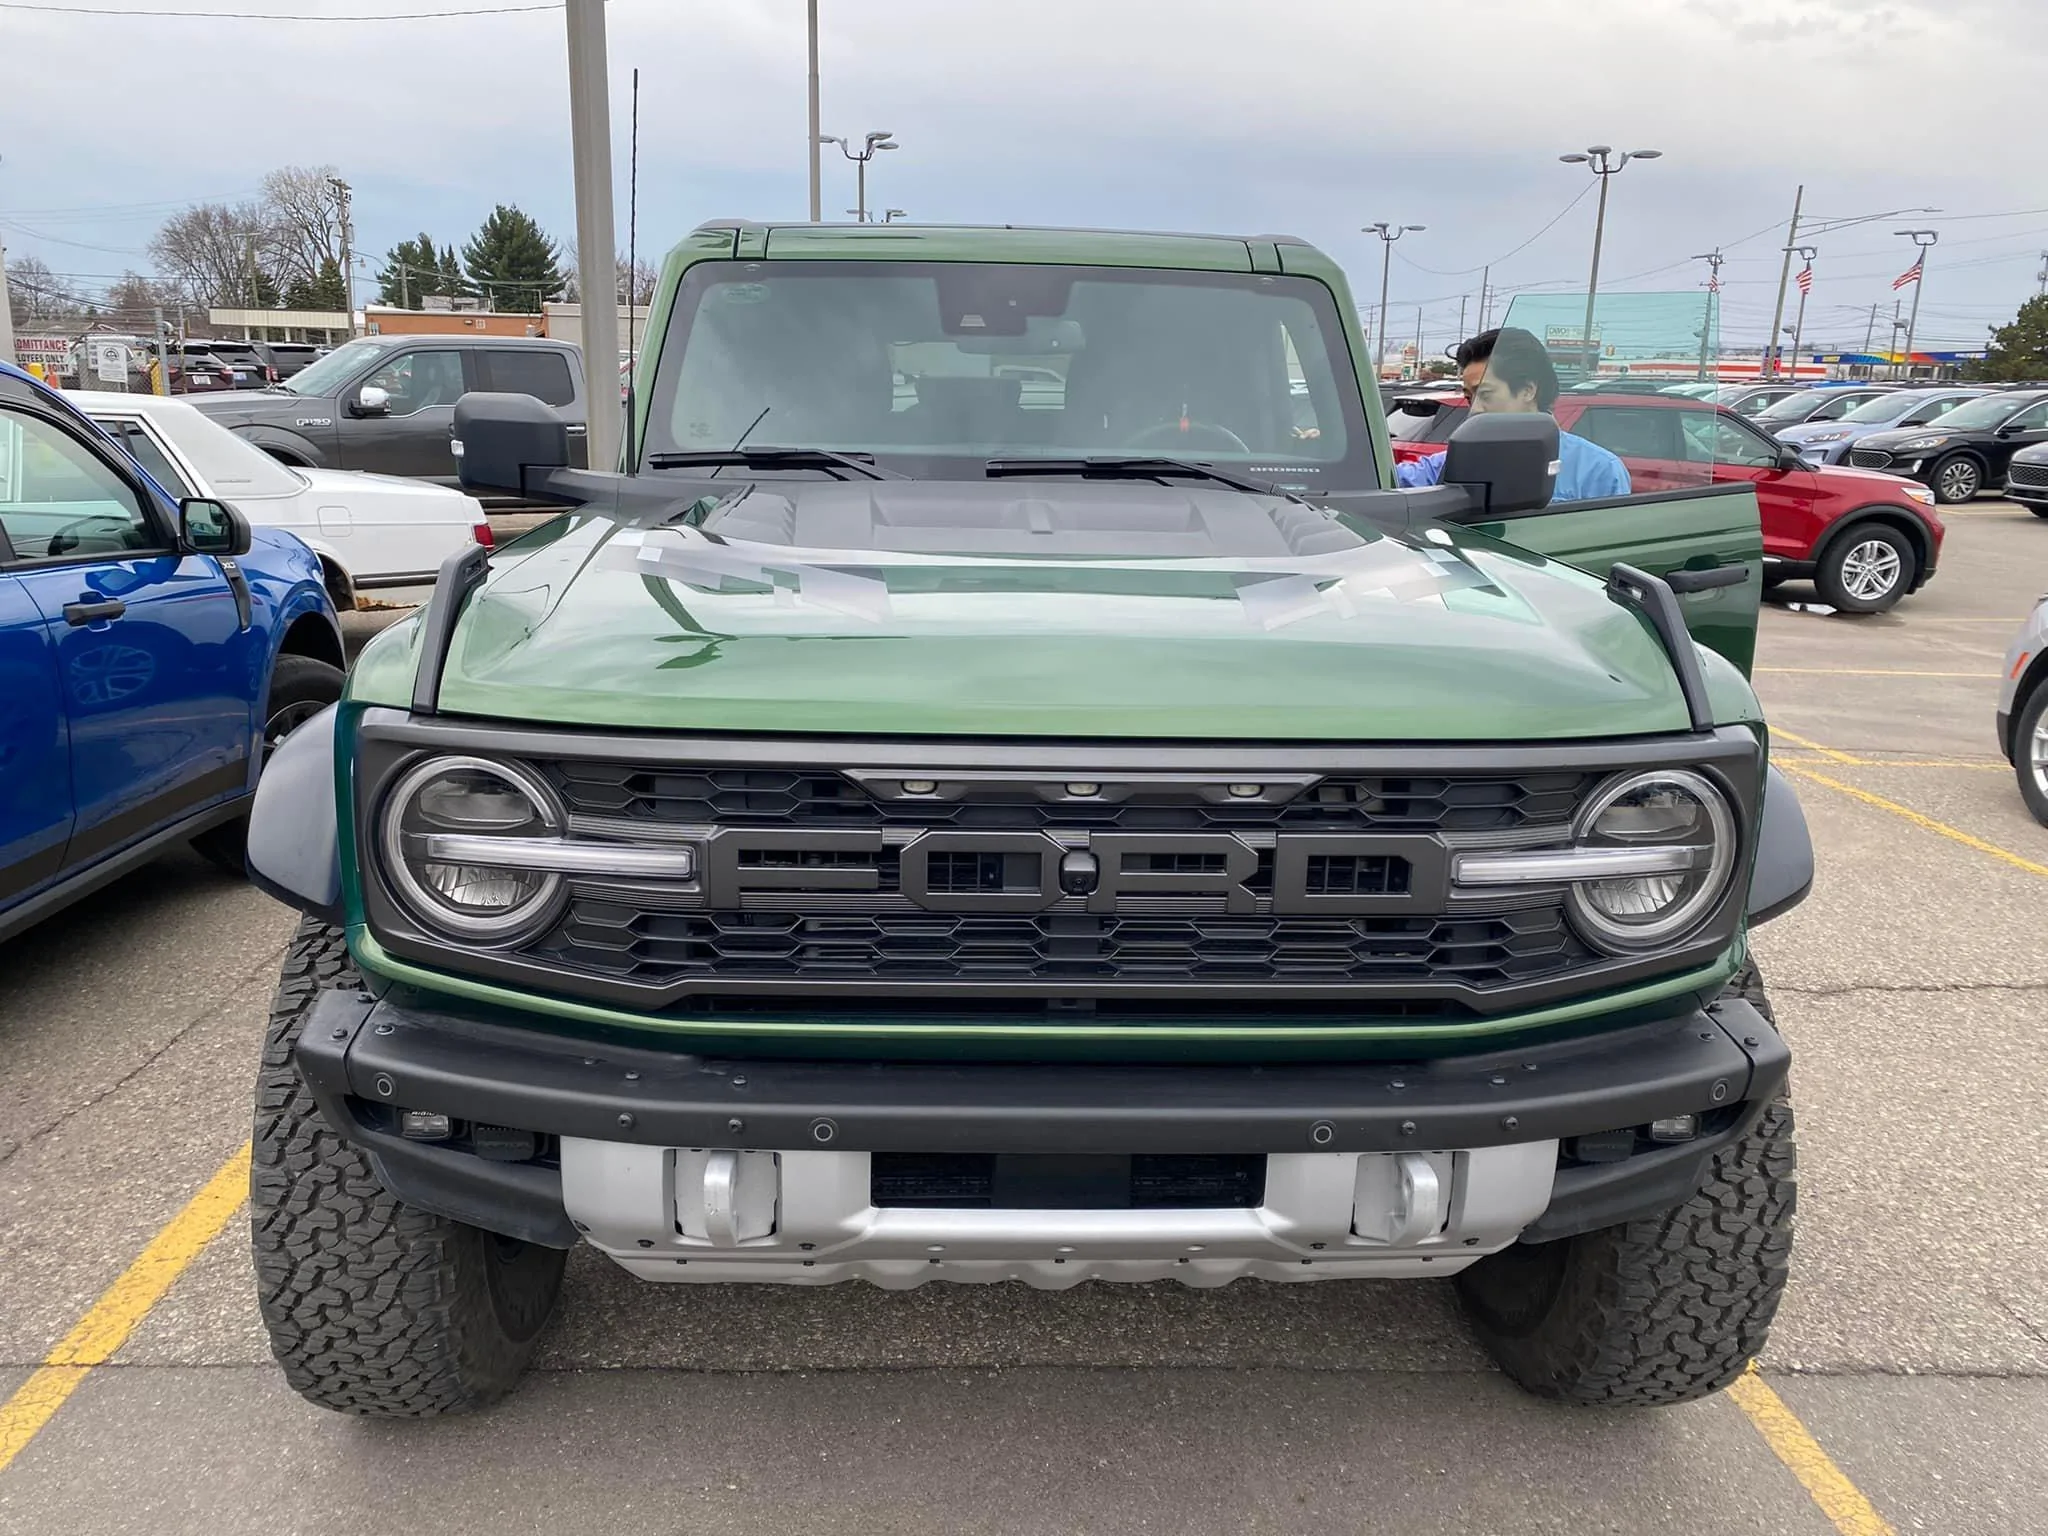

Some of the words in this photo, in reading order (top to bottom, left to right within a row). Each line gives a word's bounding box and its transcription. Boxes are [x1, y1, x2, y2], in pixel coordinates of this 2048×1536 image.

[14, 338, 68, 351] DMITTANCE
[46, 354, 64, 363] ONLY
[707, 827, 1447, 916] FORD
